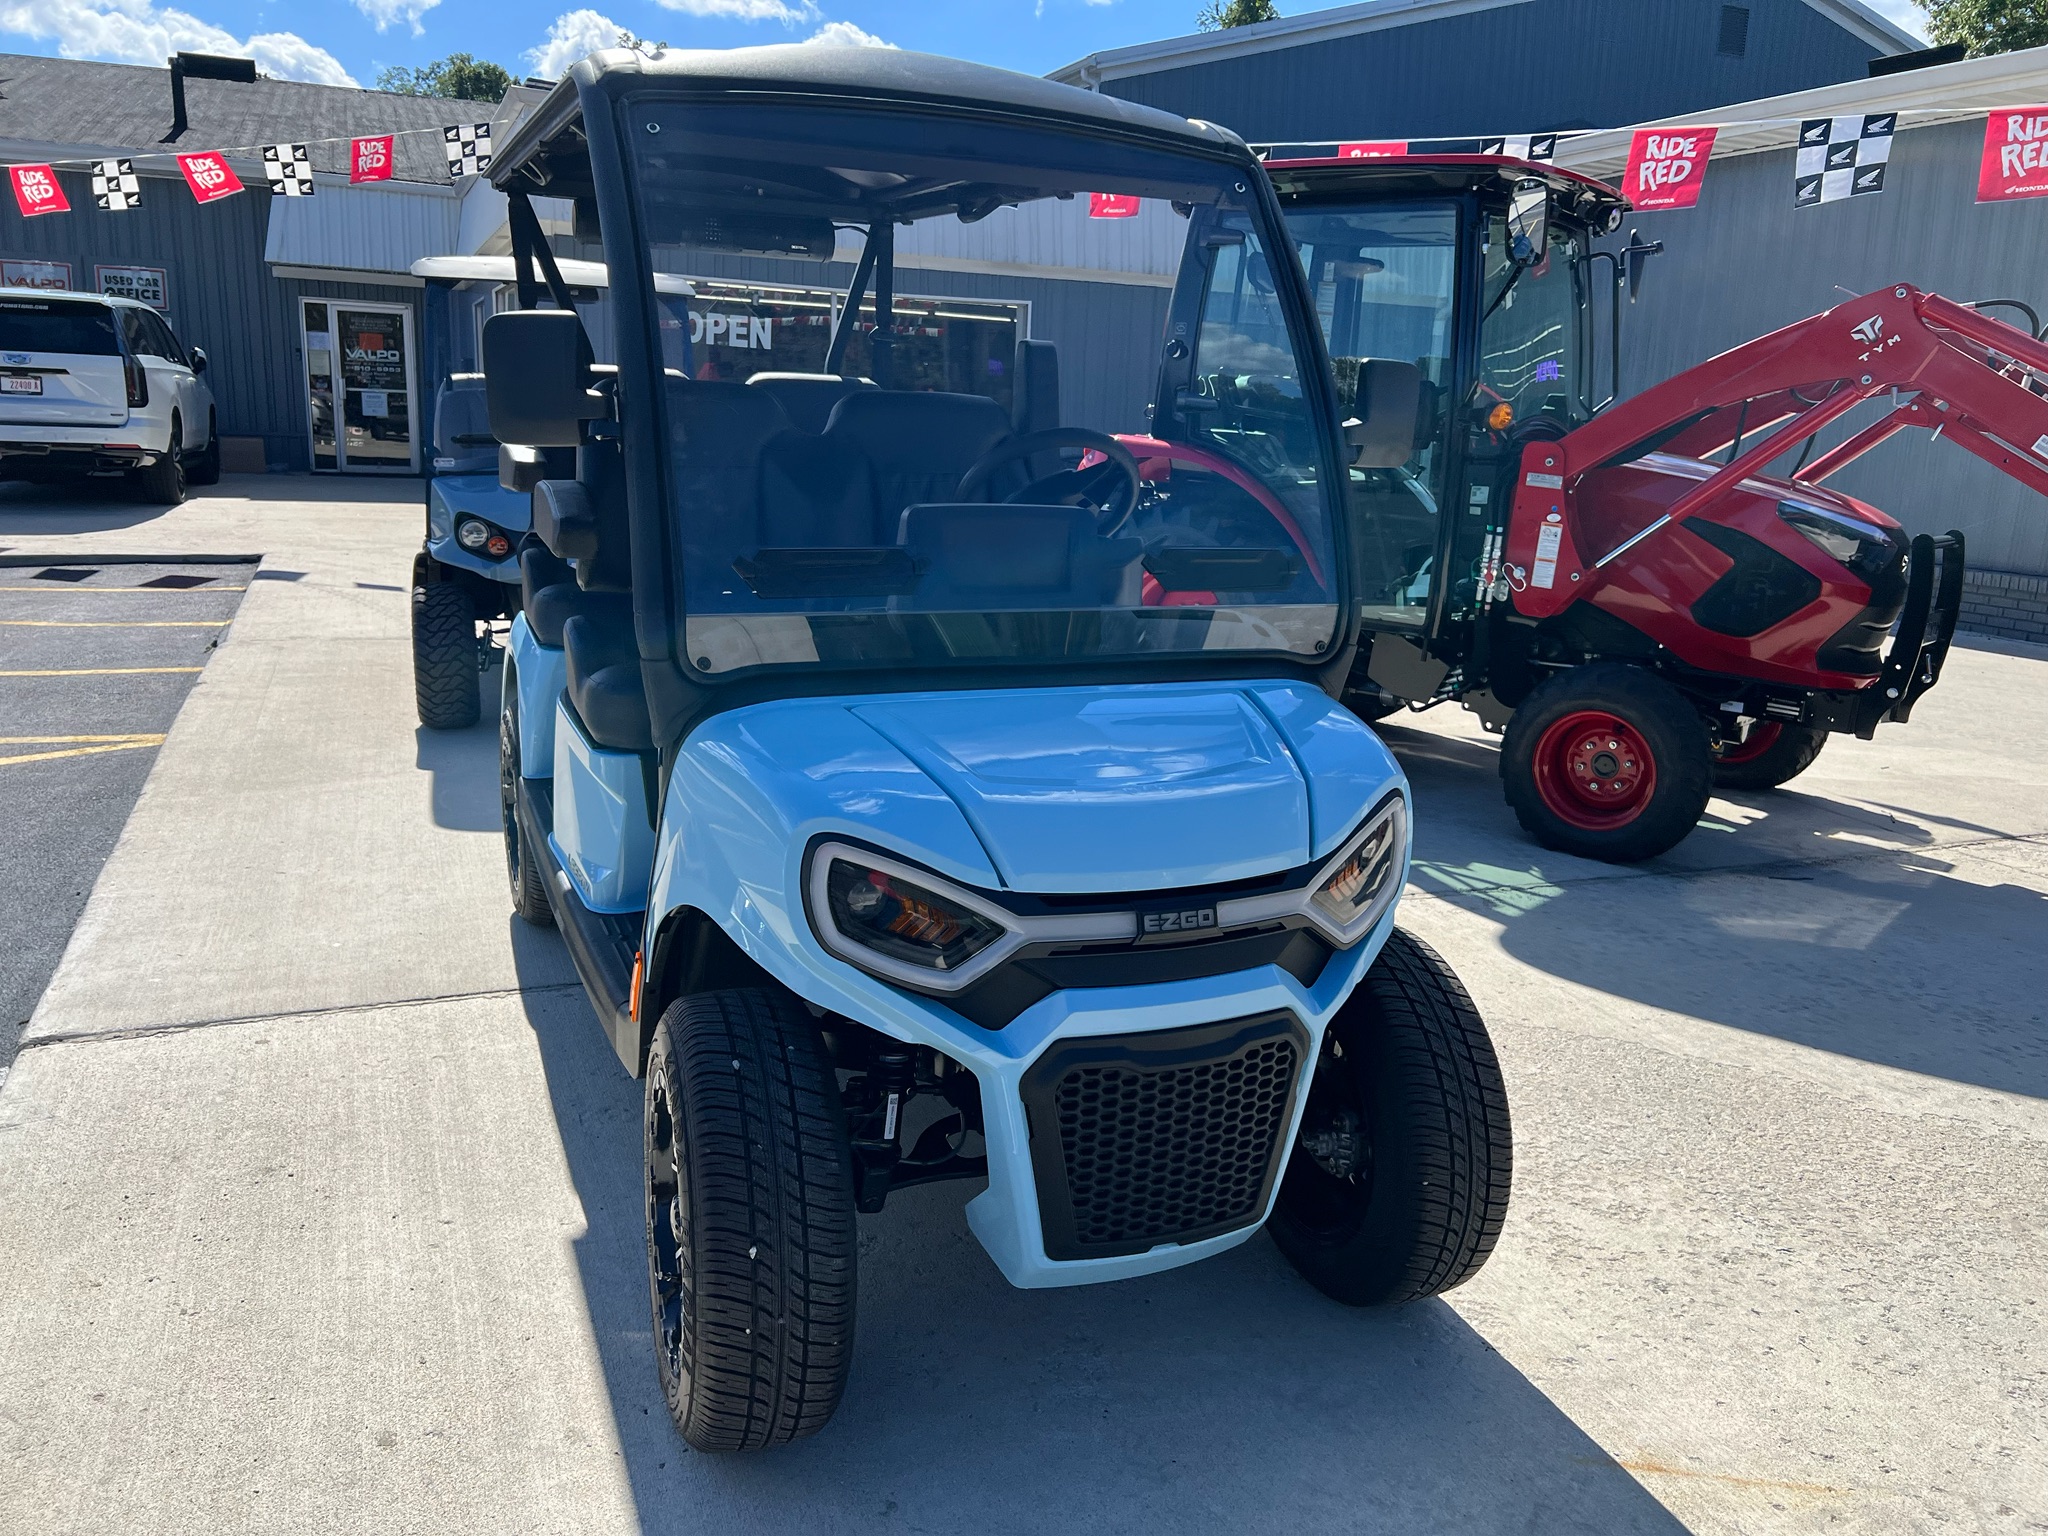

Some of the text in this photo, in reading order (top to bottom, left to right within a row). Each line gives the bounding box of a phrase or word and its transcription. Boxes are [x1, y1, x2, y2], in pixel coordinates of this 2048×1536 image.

[2007, 114, 2048, 142] RID
[358, 141, 387, 156] RIDE
[1645, 135, 1698, 160] RIDE
[185, 157, 221, 173] RIDE
[358, 153, 386, 173] RED
[17, 169, 50, 185] RIDE
[192, 169, 226, 190] RED
[1639, 159, 1693, 192] RED
[21, 184, 54, 204] RED
[1647, 197, 1676, 206] HONDA
[7, 275, 66, 289] VALPO
[104, 274, 160, 288] USED CAR
[688, 310, 773, 350] OPEN
[345, 347, 400, 361] VALPO
[1858, 334, 1901, 361] TYM
[1144, 908, 1215, 932] EZGO
